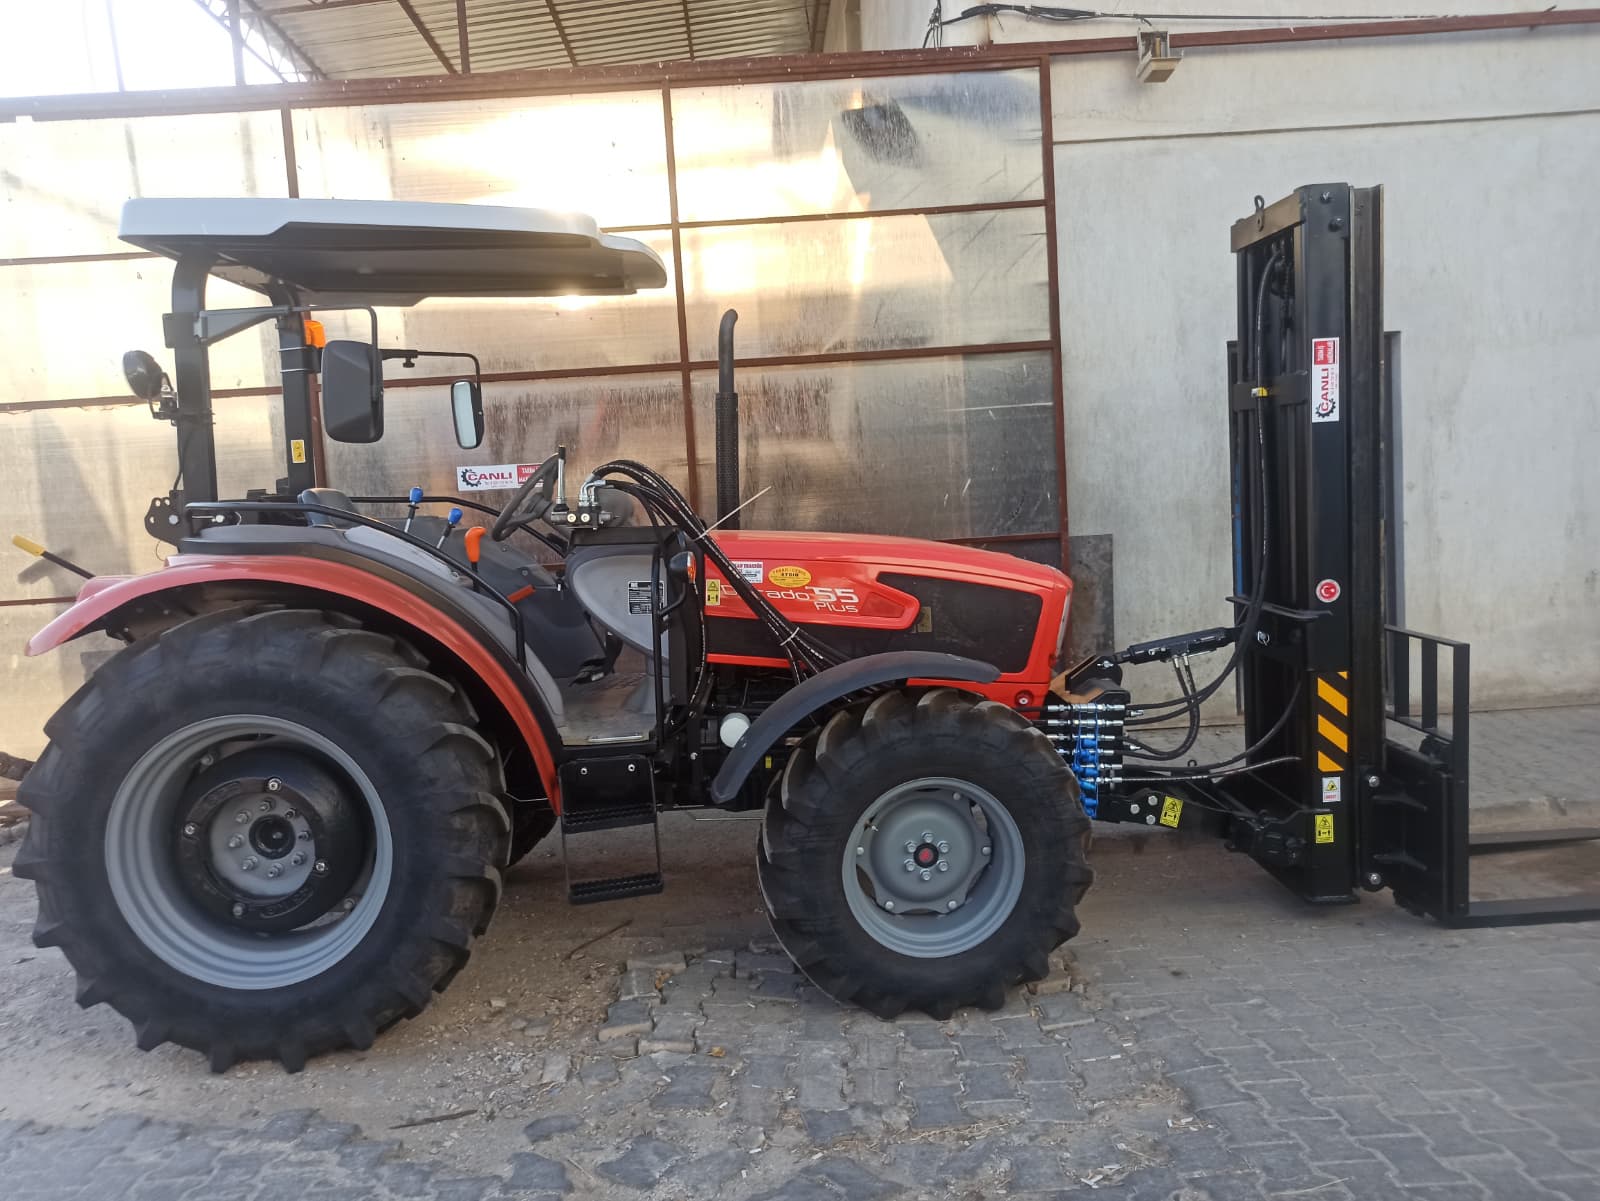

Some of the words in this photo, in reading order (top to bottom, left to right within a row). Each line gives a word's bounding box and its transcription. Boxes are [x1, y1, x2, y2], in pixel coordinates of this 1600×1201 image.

[1321, 368, 1329, 411] CANLI
[468, 471, 512, 481] CANLI
[805, 586, 859, 602] 55
